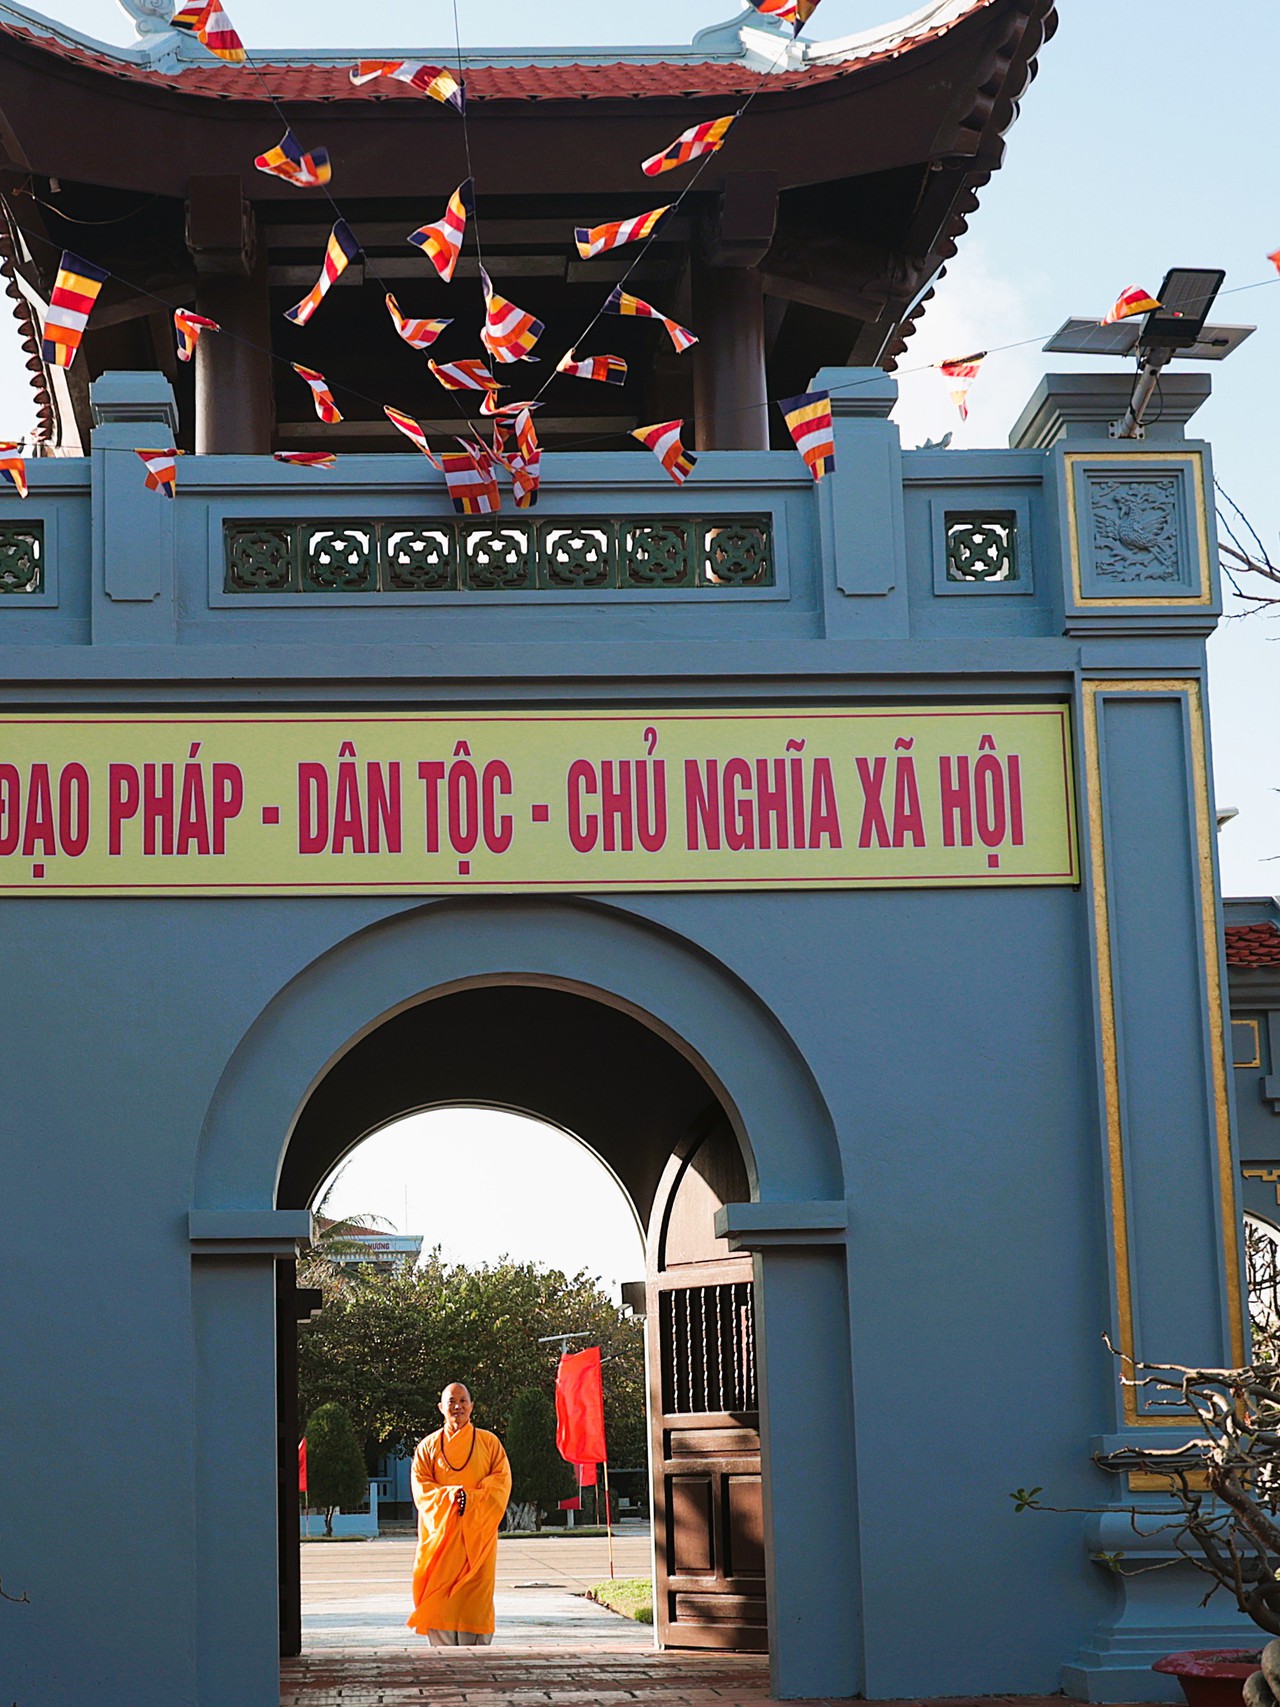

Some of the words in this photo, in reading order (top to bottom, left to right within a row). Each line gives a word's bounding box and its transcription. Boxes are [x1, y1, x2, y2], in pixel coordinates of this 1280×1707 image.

[108, 742, 244, 856] PHÁP
[298, 741, 402, 854] DÂN
[418, 740, 513, 875] TỘC
[567, 727, 667, 853] CHỦ
[685, 738, 843, 851] NGHĨA
[856, 737, 926, 848] XÃ
[939, 734, 1024, 868] HỘI
